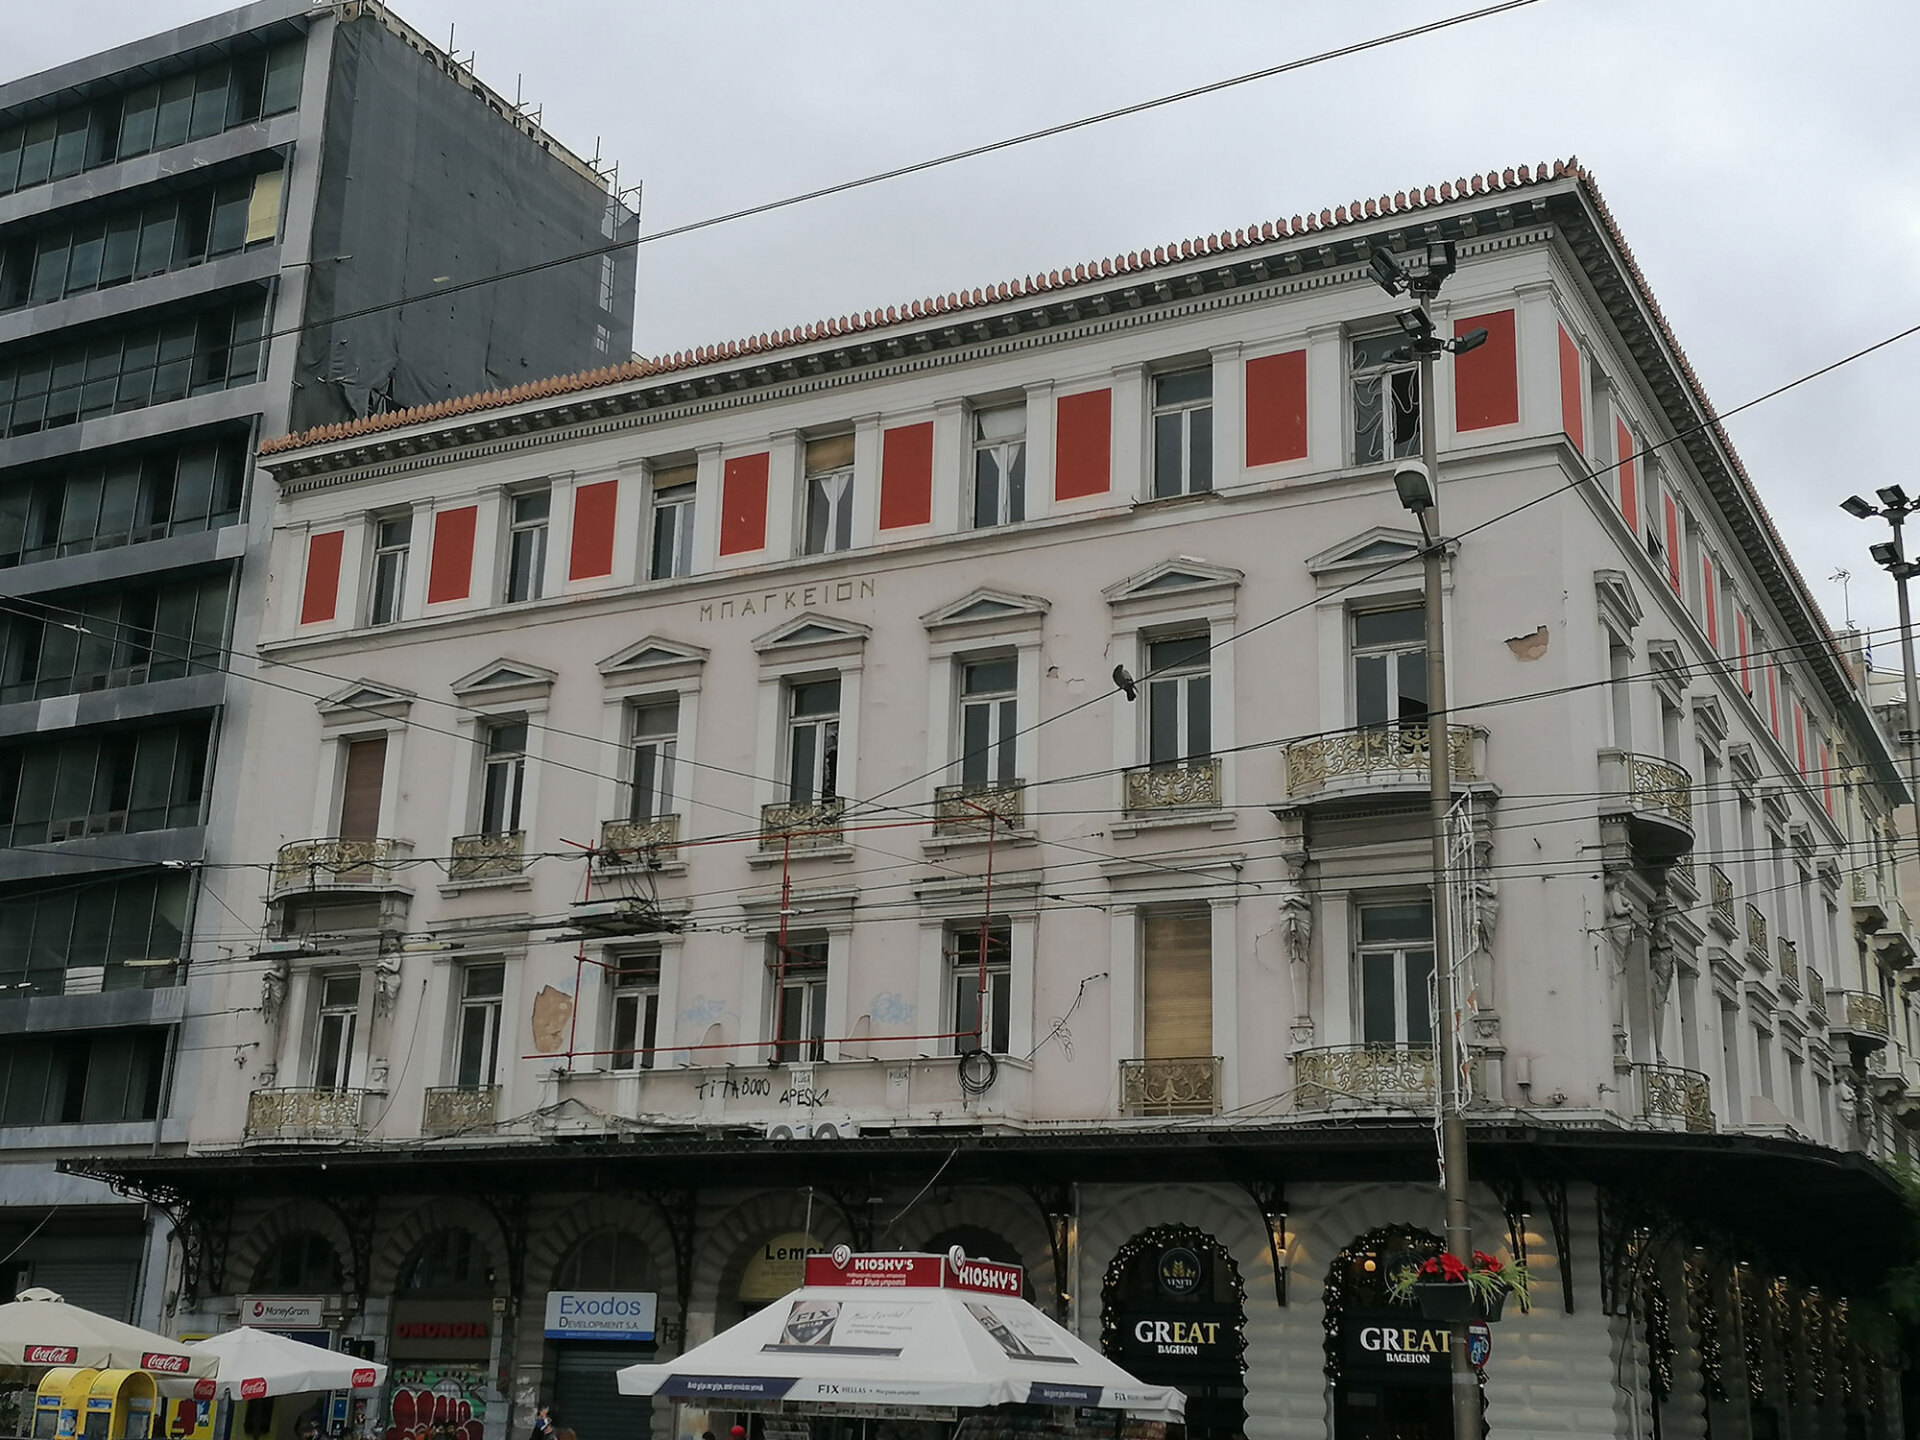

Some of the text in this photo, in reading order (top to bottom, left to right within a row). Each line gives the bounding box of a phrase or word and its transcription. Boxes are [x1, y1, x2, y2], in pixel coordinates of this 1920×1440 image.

[700, 579, 875, 622] ΜΠΑΓΚΕΙΟΝ
[855, 1259, 914, 1271] KIOSKY'S
[959, 1266, 1018, 1291] KIOSKY'S
[265, 1306, 310, 1318] MoneyGram
[560, 1295, 641, 1316] Exodos
[796, 1309, 831, 1322] FIX
[396, 1322, 487, 1338] OMONOIA
[1135, 1320, 1220, 1344] GREAT
[1360, 1327, 1451, 1353] GREAT
[1158, 1345, 1198, 1355] BAGEION
[1386, 1353, 1430, 1363] BAGEION
[817, 1384, 840, 1394] FIX
